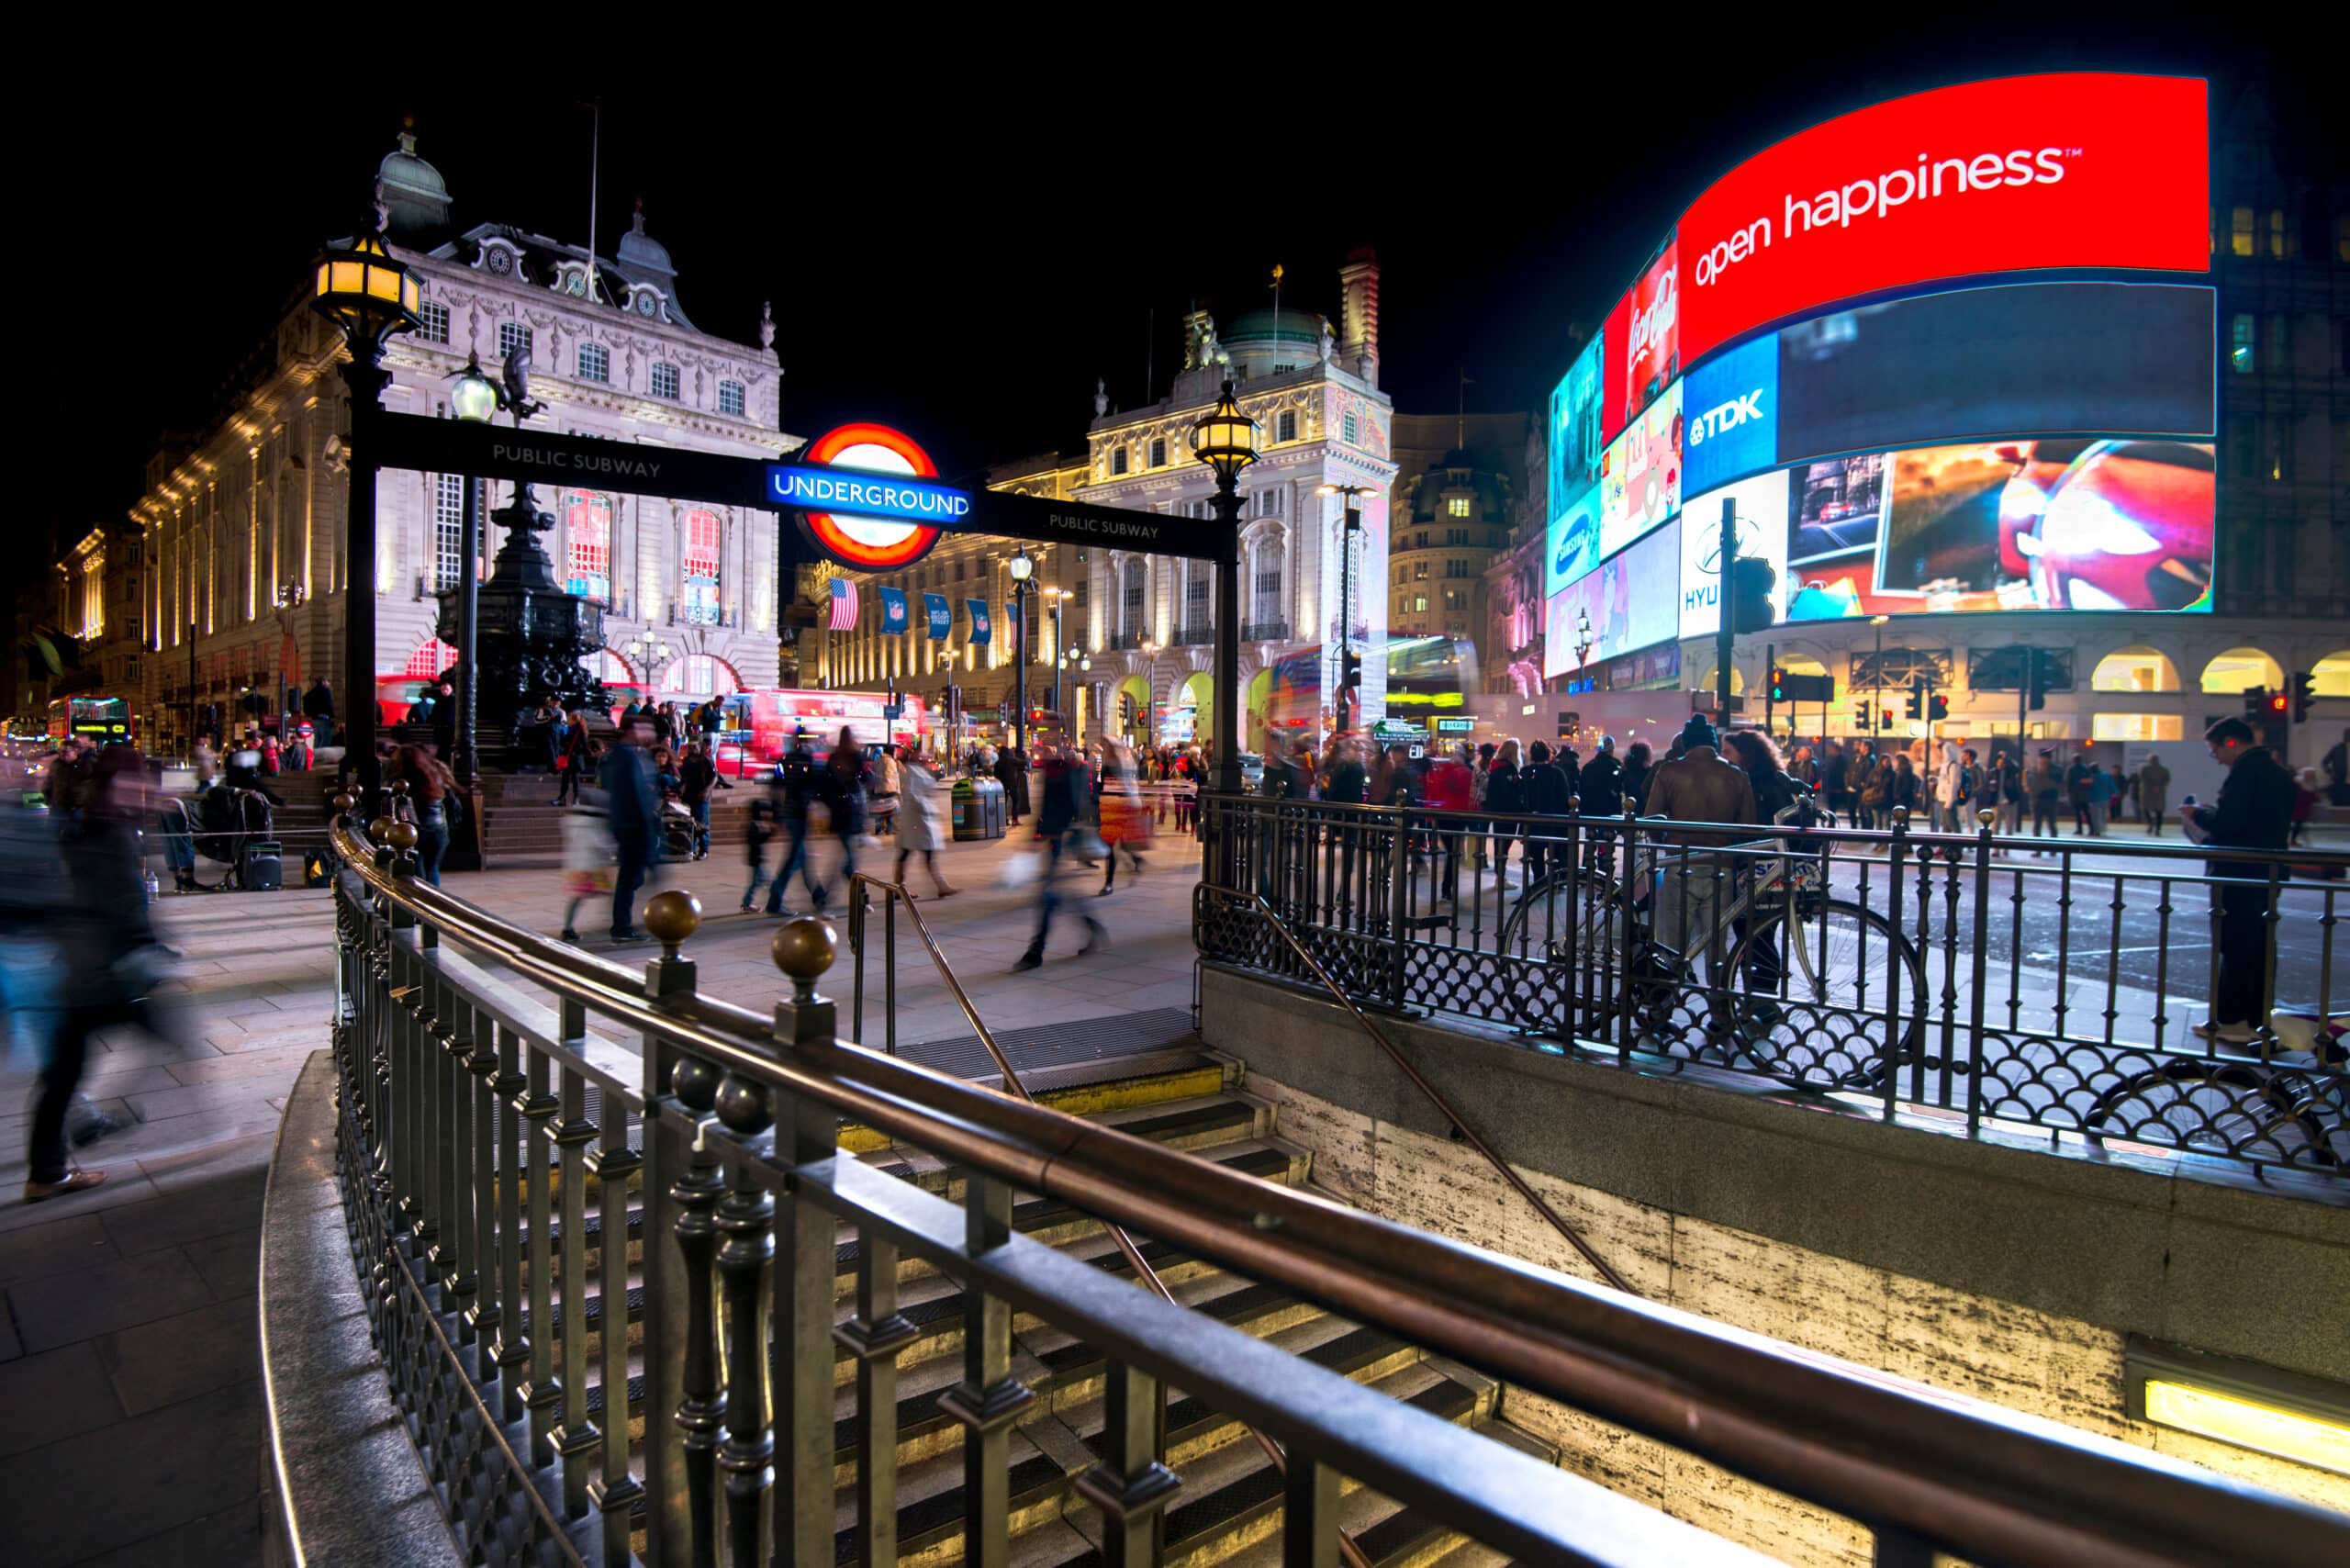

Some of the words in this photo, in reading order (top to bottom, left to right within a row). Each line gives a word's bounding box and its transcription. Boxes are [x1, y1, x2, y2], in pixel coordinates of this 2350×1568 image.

[1695, 217, 1771, 286] open
[1703, 387, 1763, 438] TDK
[493, 444, 566, 467] PUBLIC
[574, 454, 661, 477] SUBWAY
[775, 474, 969, 515] UNDERGROUND
[1050, 514, 1099, 532] PUBLIC
[1102, 521, 1158, 539] SUBWAY
